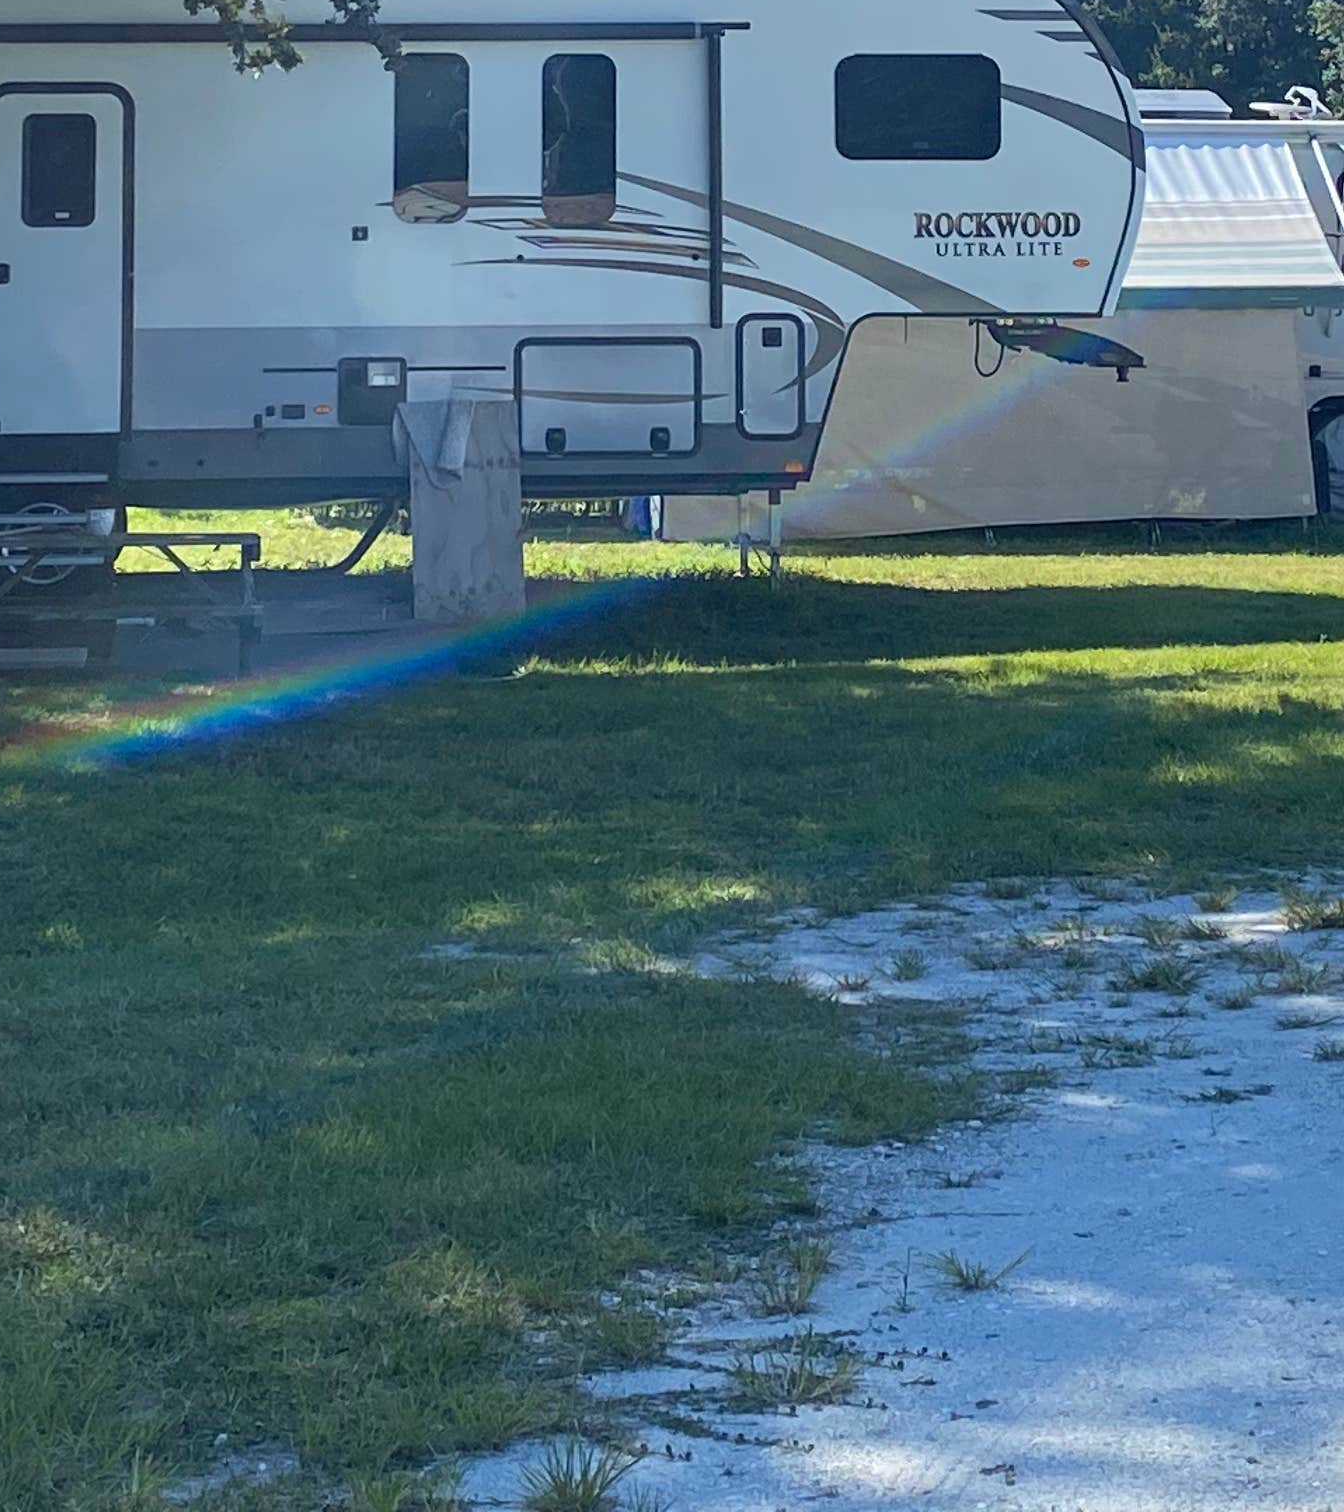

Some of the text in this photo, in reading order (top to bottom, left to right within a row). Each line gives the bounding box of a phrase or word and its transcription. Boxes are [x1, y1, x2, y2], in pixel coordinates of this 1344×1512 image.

[913, 212, 1081, 239] ROCKWOOD
[935, 241, 1064, 257] ULTRA LITE
